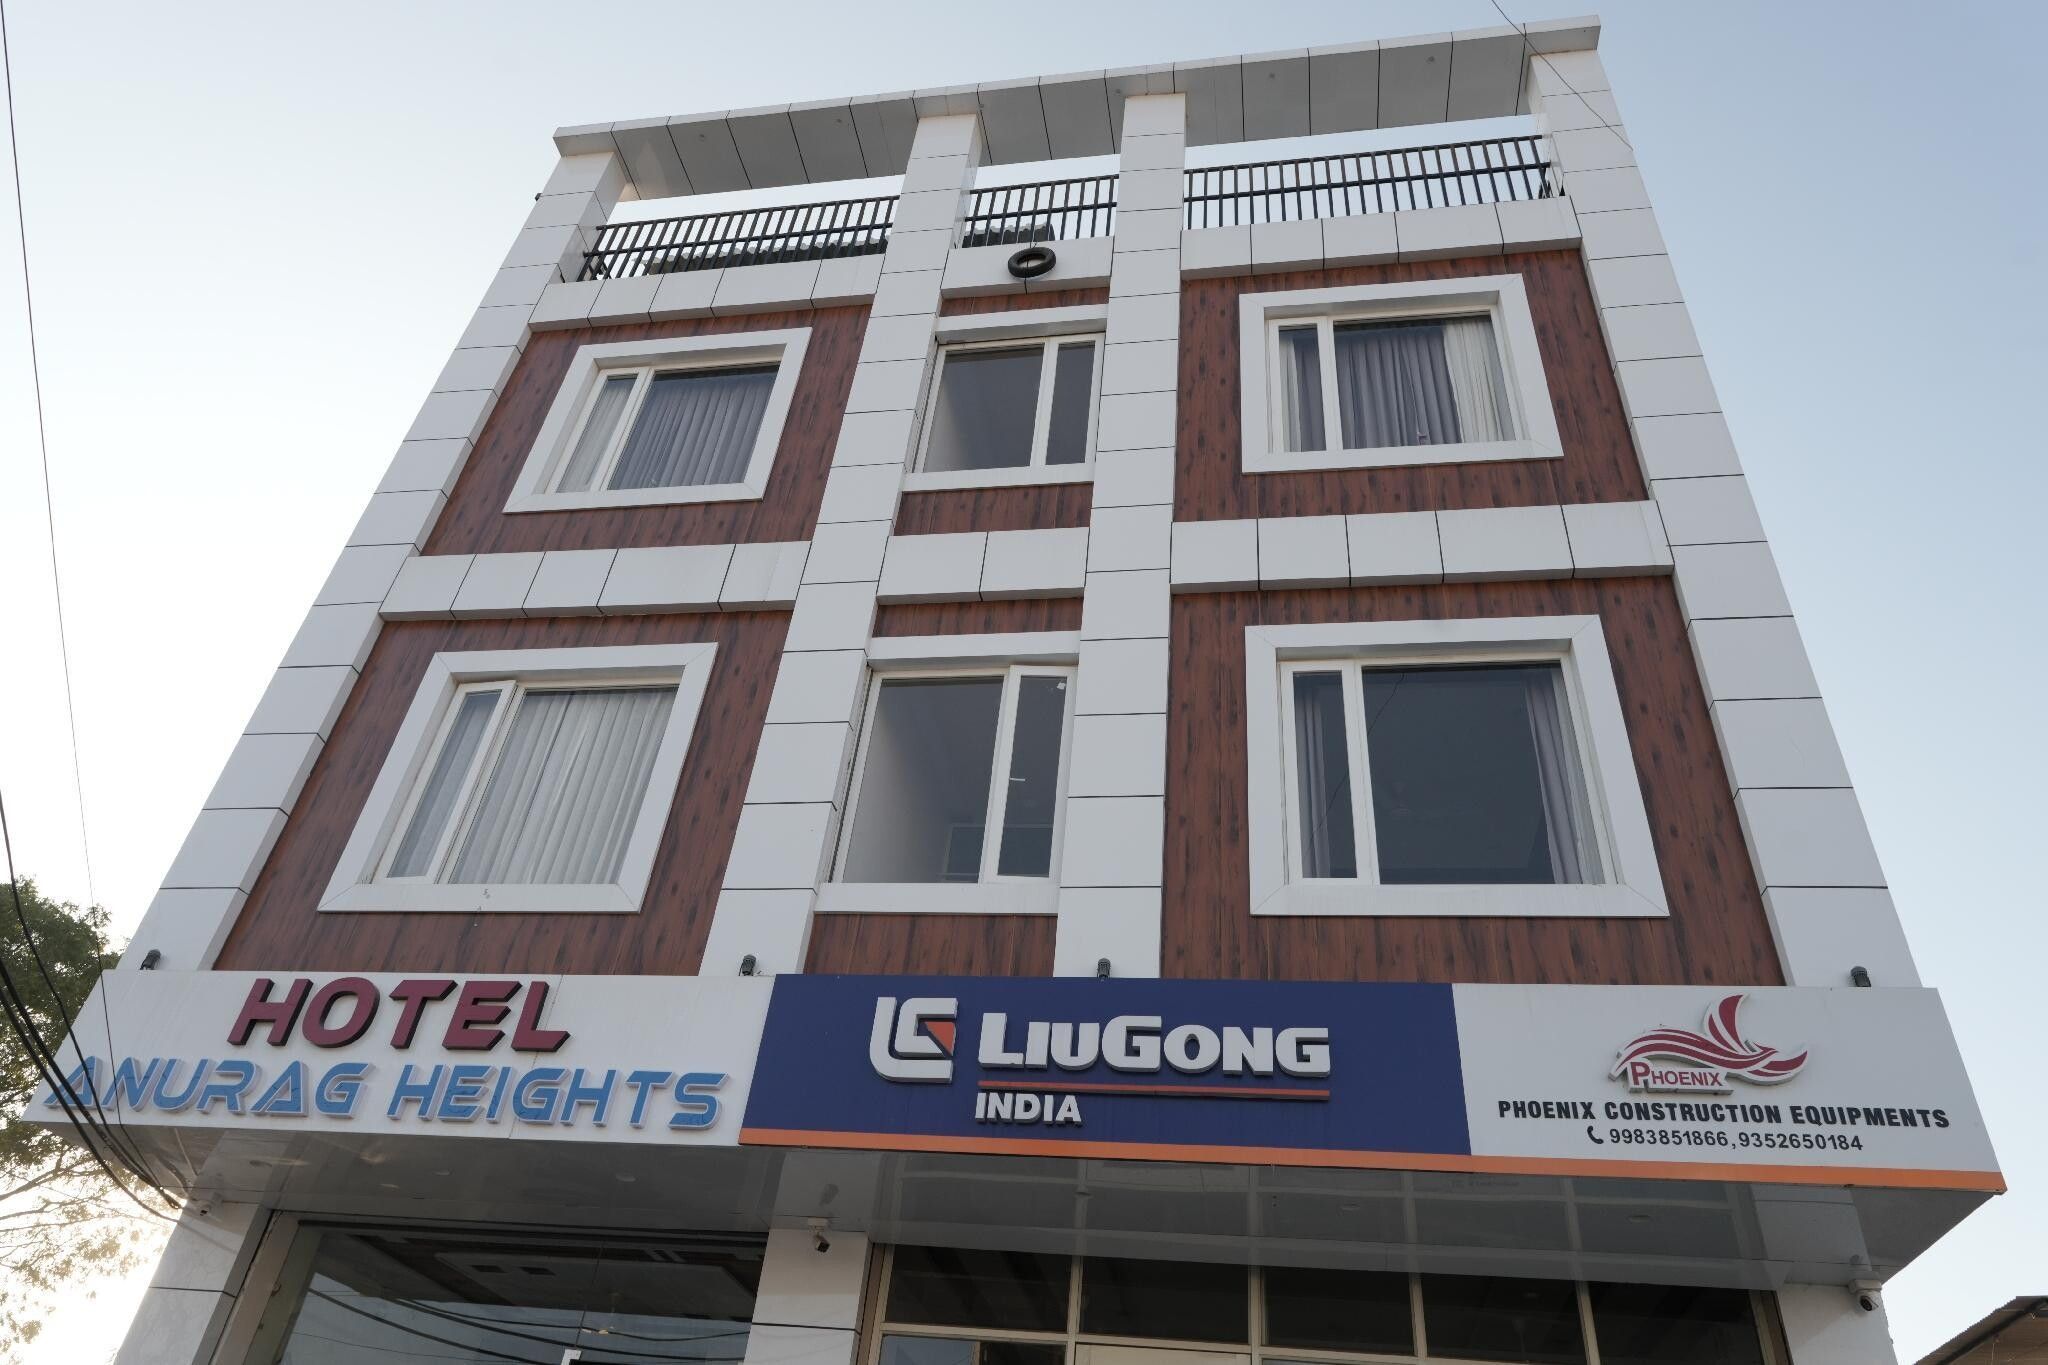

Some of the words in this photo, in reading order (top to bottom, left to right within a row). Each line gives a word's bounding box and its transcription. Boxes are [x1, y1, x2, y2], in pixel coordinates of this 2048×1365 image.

[227, 976, 571, 1052] HOTEL
[42, 1055, 376, 1119] ANURAG
[386, 1063, 732, 1131] HEIGHTS
[974, 1090, 1083, 1125] INDIA
[1497, 1100, 1596, 1120] PHOENIX
[1604, 1102, 1782, 1124] CONSTRUCTION
[1789, 1104, 1950, 1128] EQUIPMENTS
